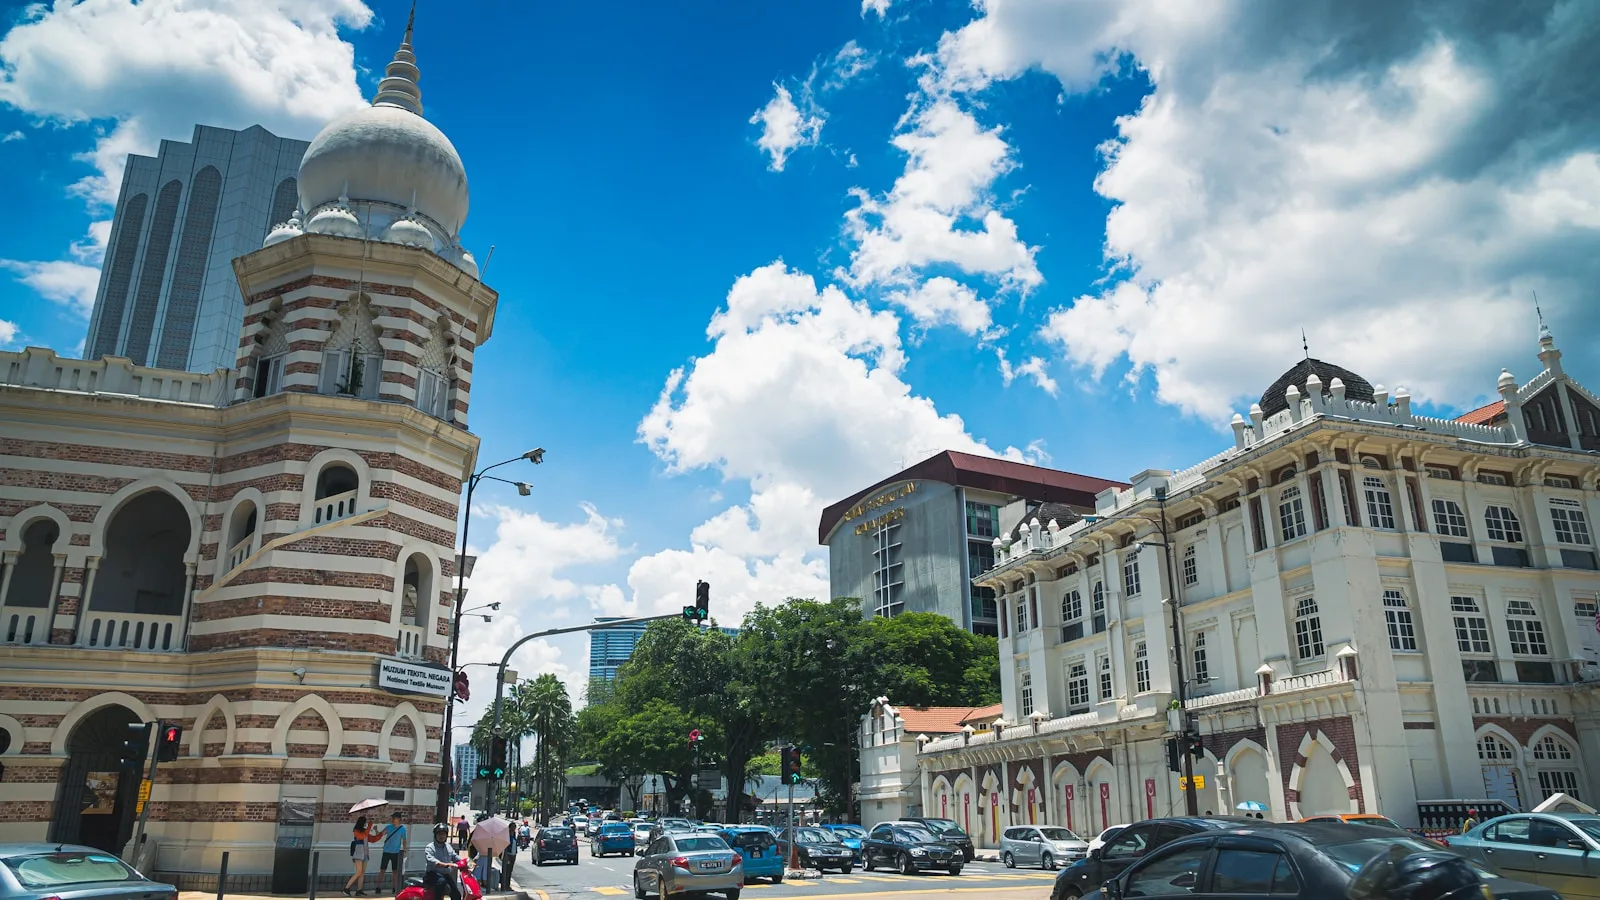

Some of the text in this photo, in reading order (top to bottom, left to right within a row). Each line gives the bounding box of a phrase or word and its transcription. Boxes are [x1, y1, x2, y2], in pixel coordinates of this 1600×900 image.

[383, 665, 451, 683] MUZIUM TEKSTIL NEGARA
[386, 675, 446, 690] National Textile Museum
